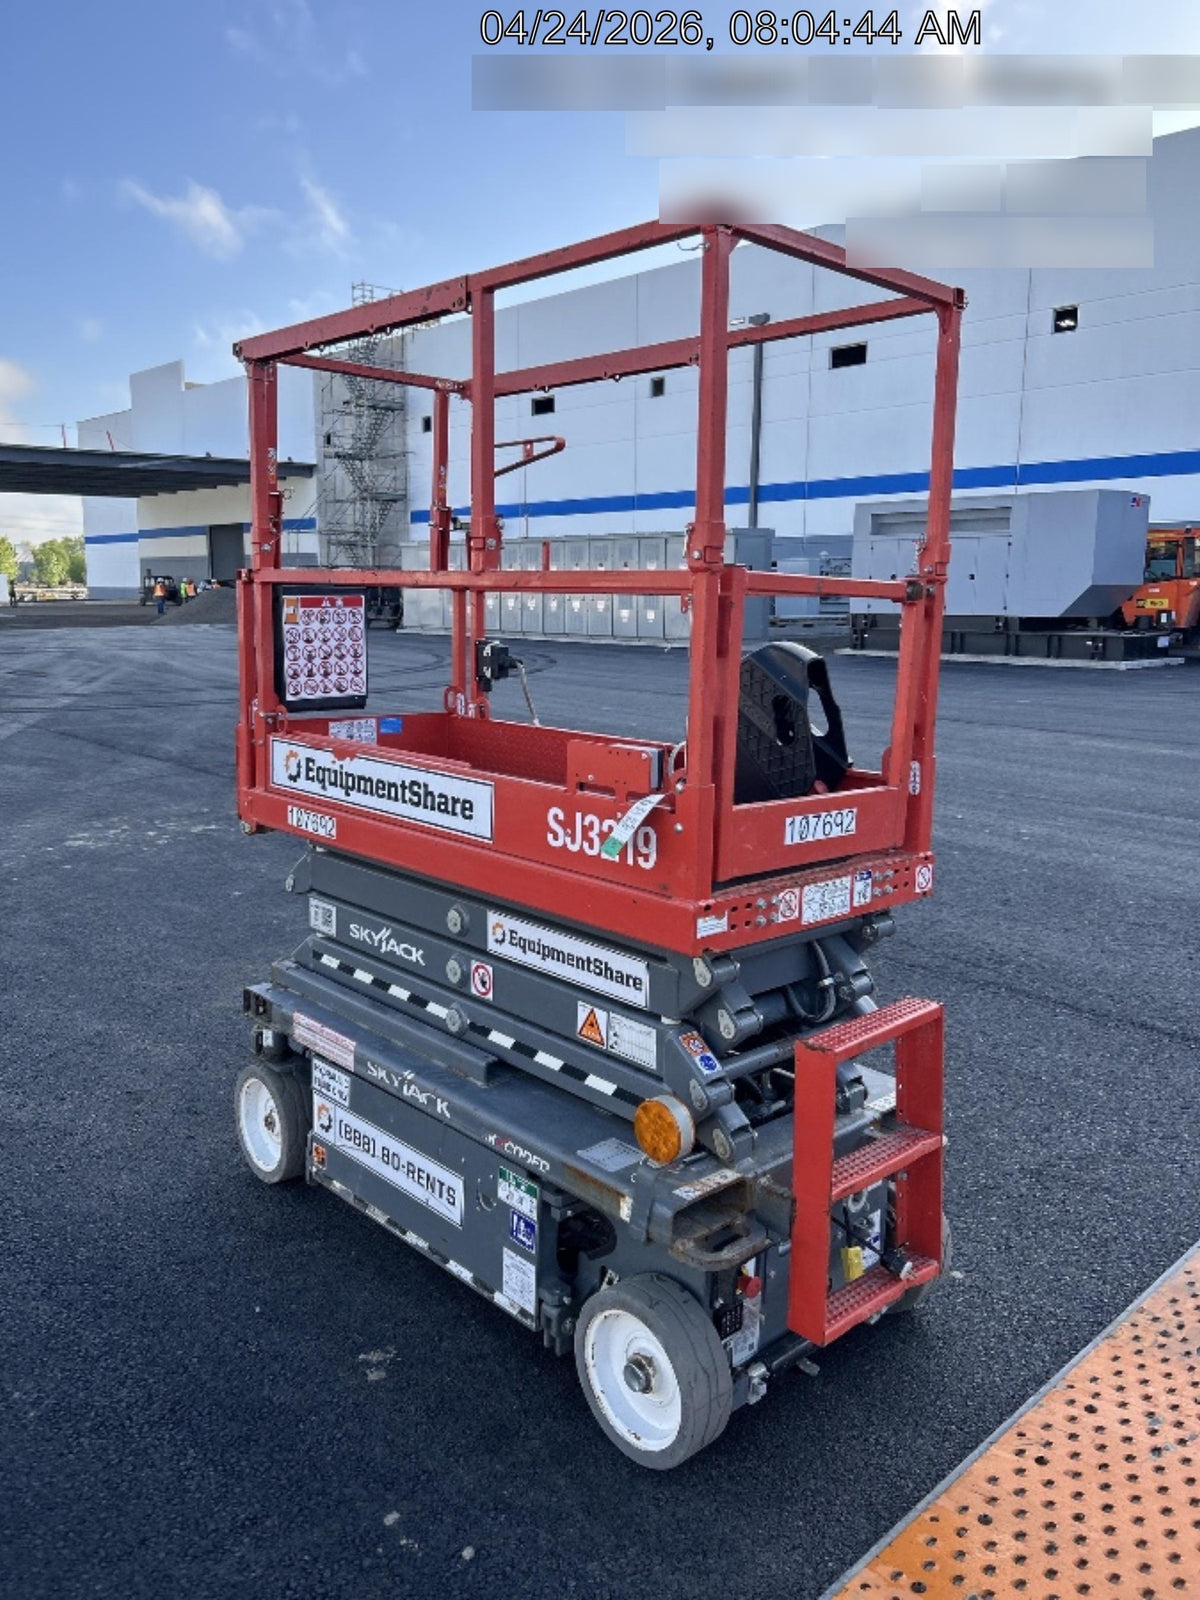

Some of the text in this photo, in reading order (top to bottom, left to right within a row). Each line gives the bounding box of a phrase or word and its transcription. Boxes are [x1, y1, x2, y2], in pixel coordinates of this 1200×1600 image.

[304, 757, 475, 821] EquipmentShare
[288, 806, 336, 839] 107692
[788, 809, 856, 844] 107692
[349, 923, 427, 967] SKYJACK
[507, 928, 644, 992] EquipmentShare
[381, 1146, 457, 1208] 80-RENTS
